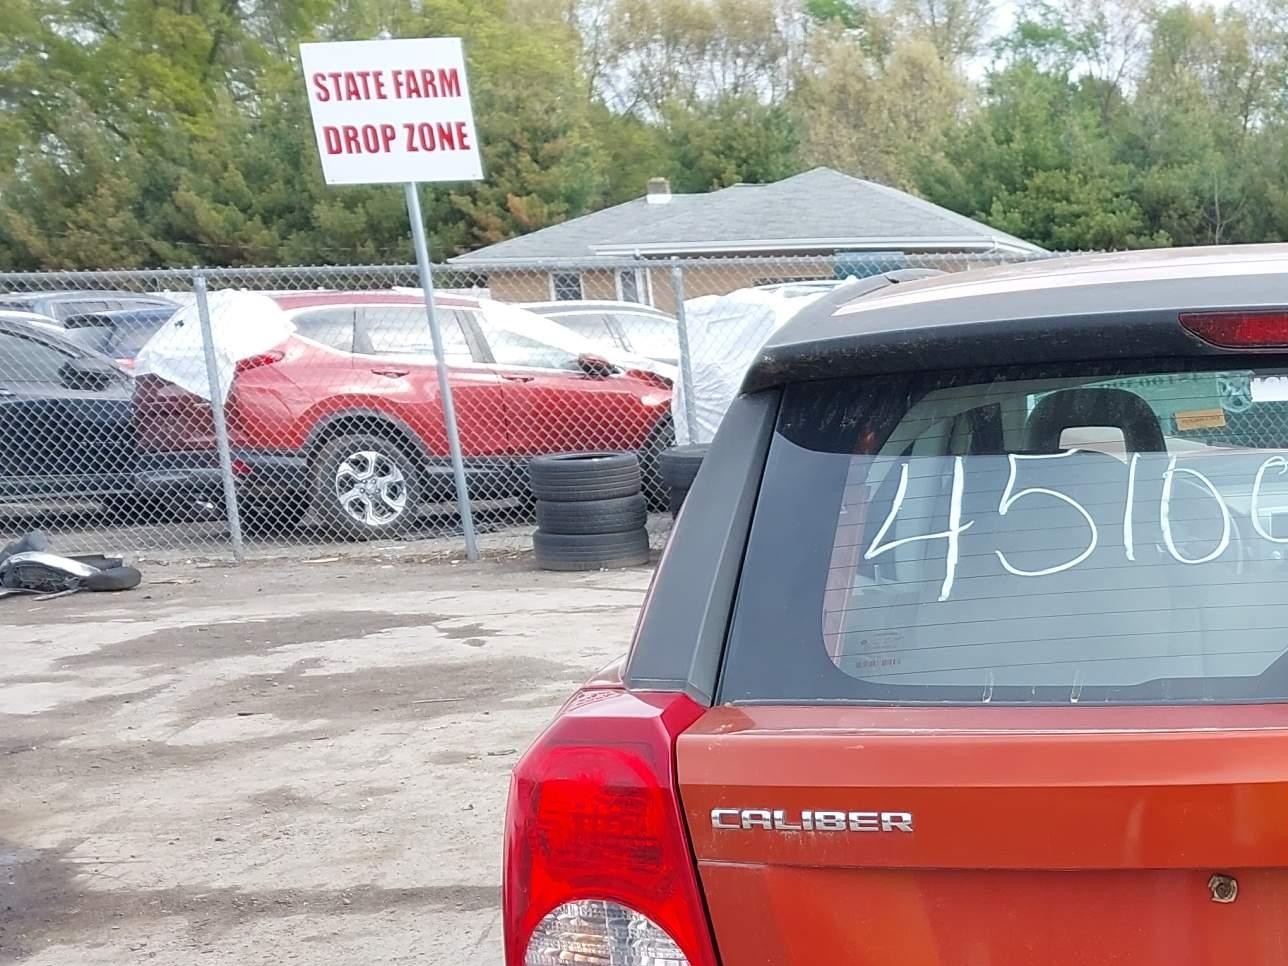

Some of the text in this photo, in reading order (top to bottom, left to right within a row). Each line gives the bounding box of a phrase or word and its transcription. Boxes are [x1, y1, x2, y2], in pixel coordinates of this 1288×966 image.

[311, 67, 462, 103] STATE FARM
[322, 120, 472, 155] DROP ZONE
[710, 808, 914, 832] CALIBER
